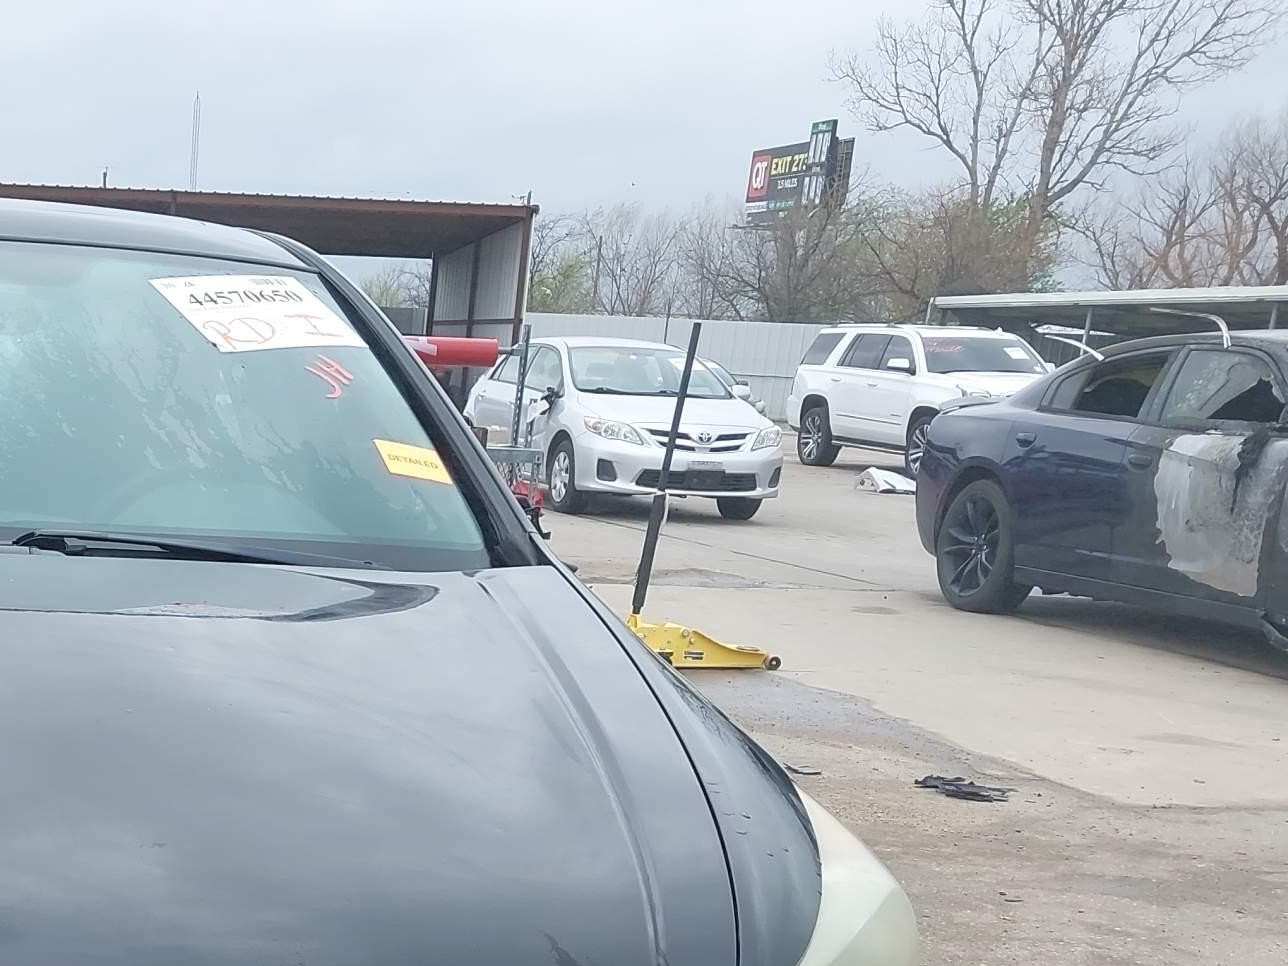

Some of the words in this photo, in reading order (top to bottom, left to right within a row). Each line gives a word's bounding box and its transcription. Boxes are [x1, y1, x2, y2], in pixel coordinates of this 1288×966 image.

[752, 160, 768, 190] QT
[770, 156, 792, 176] EXIT
[188, 290, 304, 307] 44570650
[387, 453, 439, 470] DETAILED
